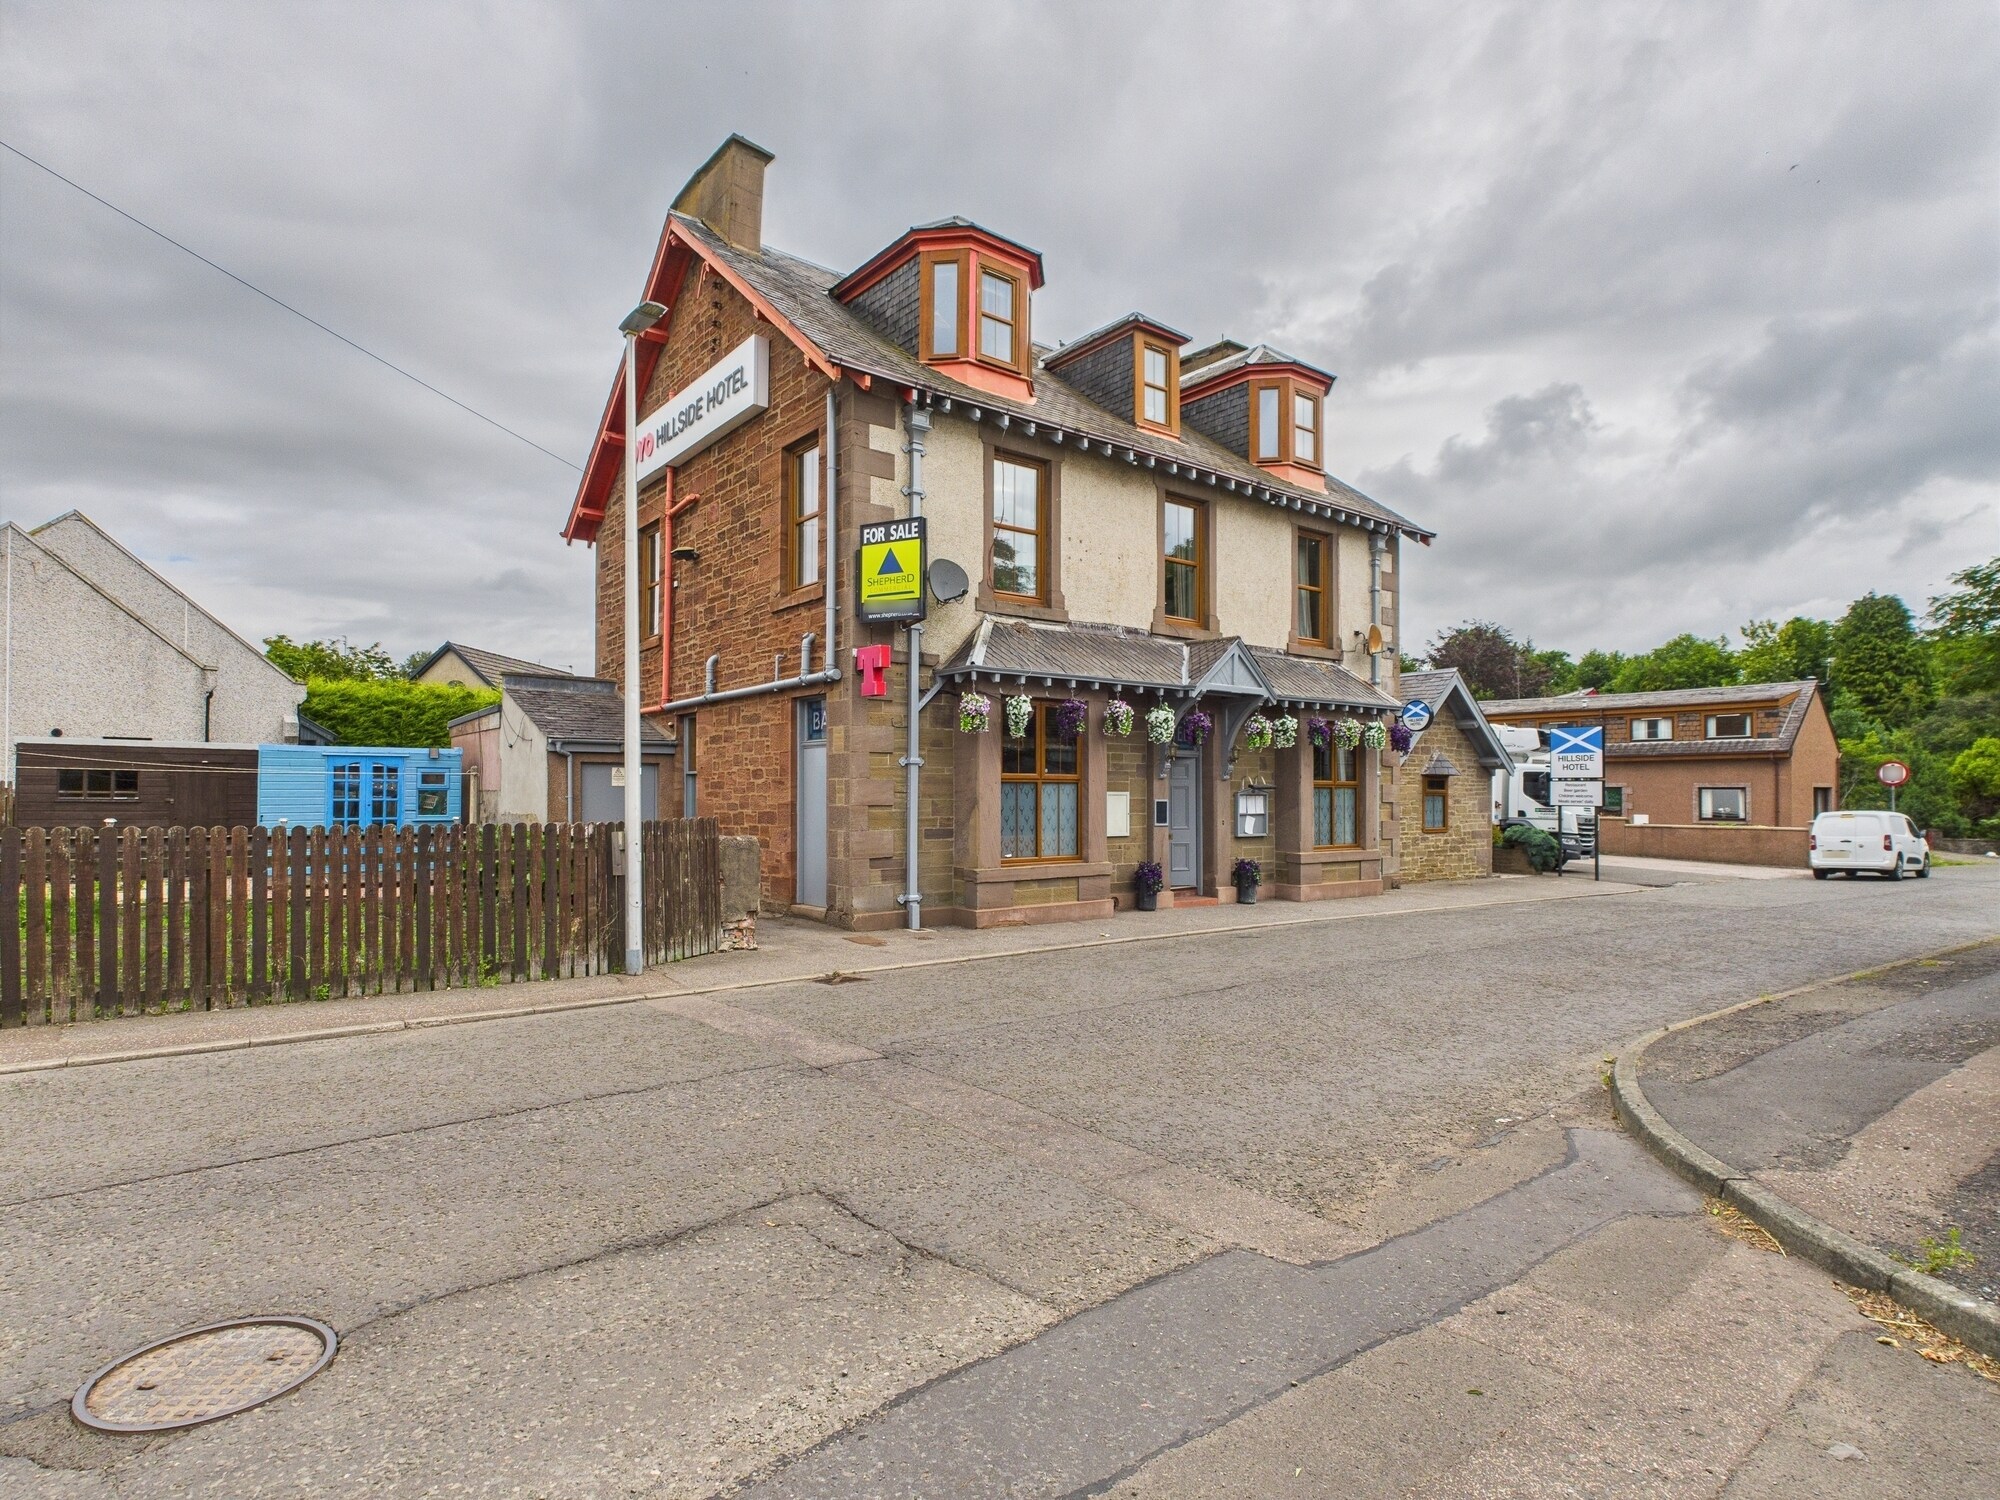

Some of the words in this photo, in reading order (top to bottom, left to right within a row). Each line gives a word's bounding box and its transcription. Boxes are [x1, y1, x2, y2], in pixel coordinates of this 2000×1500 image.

[656, 396, 704, 448] HILLSIDE
[706, 365, 749, 412] HOTEL
[863, 526, 886, 544] FOR
[890, 522, 919, 540] SALE
[867, 573, 915, 587] SHEPHERD
[1558, 754, 1595, 762] HILLSIDE
[1562, 763, 1590, 771] HOTEL
